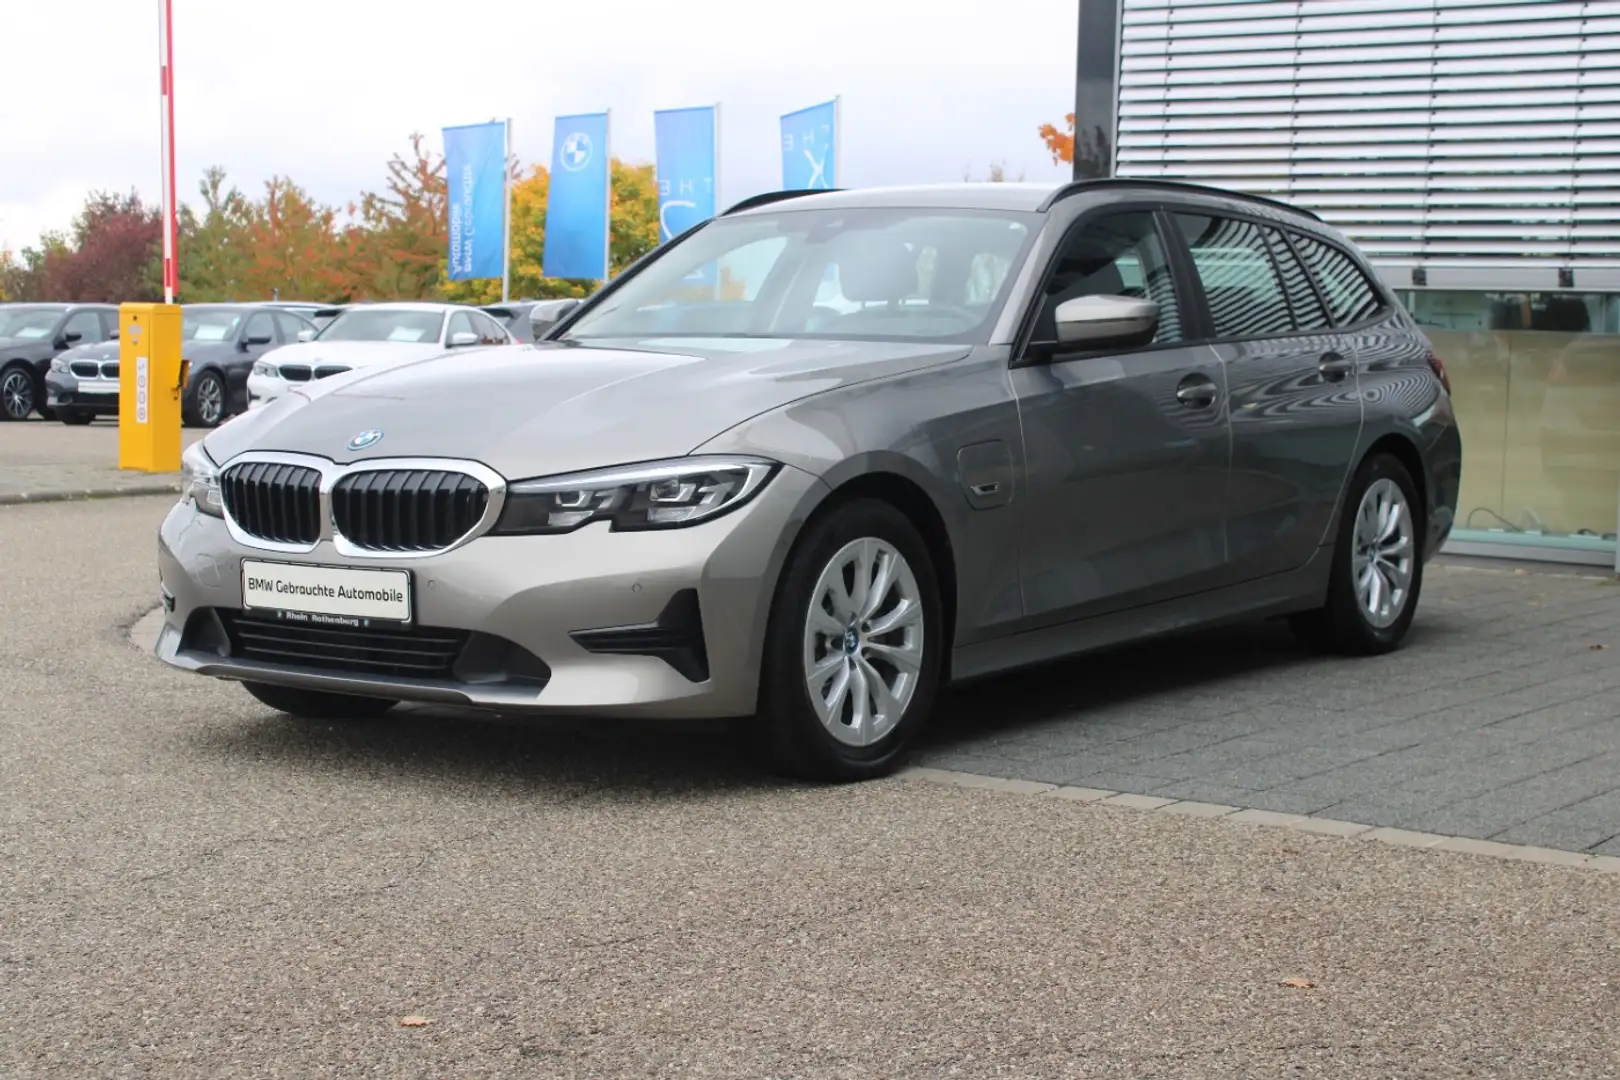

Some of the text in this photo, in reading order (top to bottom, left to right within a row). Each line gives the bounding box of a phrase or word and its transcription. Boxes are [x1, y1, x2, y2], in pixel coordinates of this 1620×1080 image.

[248, 577, 403, 602] BMW Gebrauchte Automobile
[286, 611, 308, 621] Rhein
